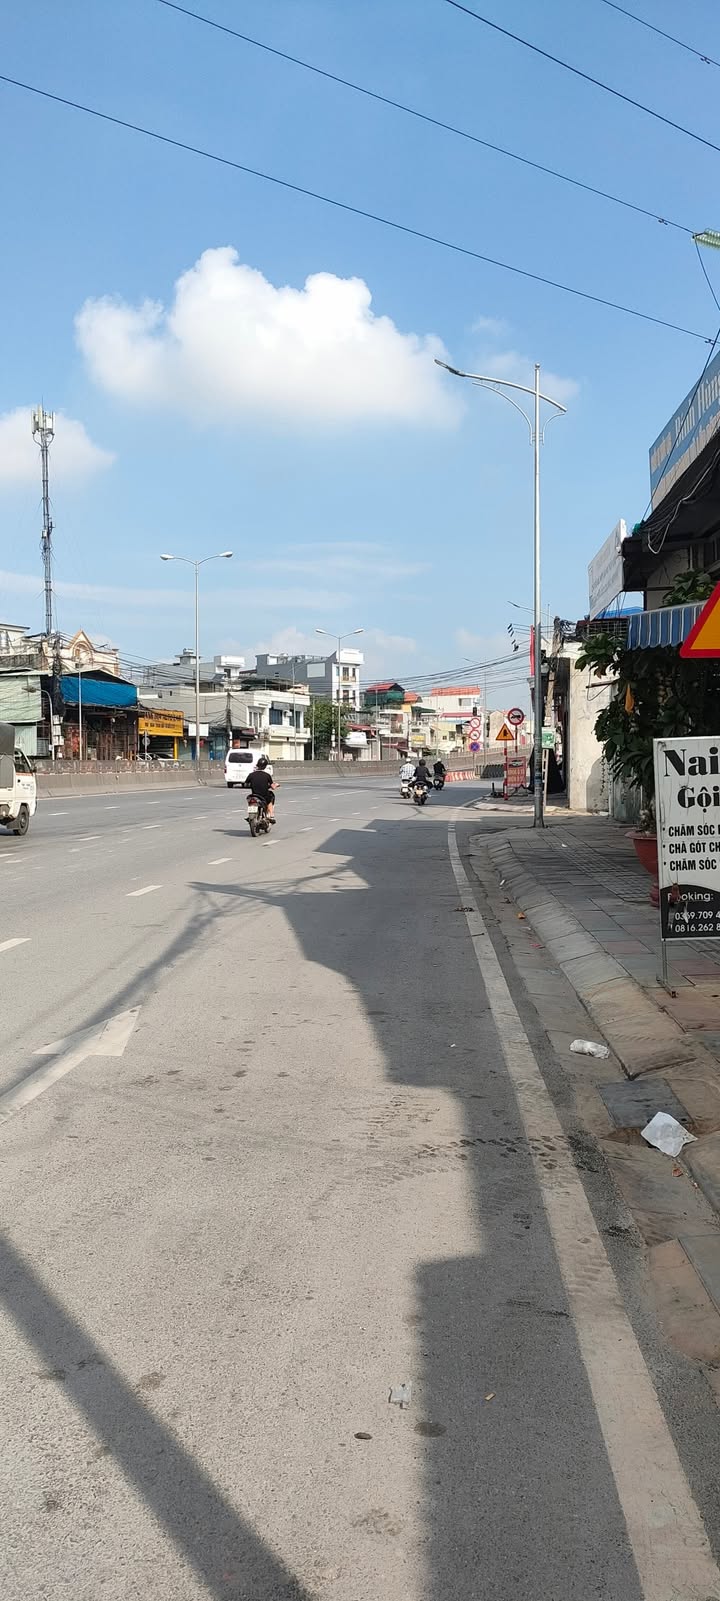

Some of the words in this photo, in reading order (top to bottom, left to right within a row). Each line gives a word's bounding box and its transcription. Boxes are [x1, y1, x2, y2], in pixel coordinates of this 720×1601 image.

[663, 747, 720, 777] Nai
[677, 785, 720, 813] Gội
[668, 823, 695, 837] CHĂM
[697, 822, 715, 836] SÓC
[689, 840, 706, 853] GÓT
[669, 858, 696, 871] CHĂM
[699, 857, 717, 870] SÓC
[667, 891, 714, 902] oking:
[674, 923, 714, 932] 0816.262
